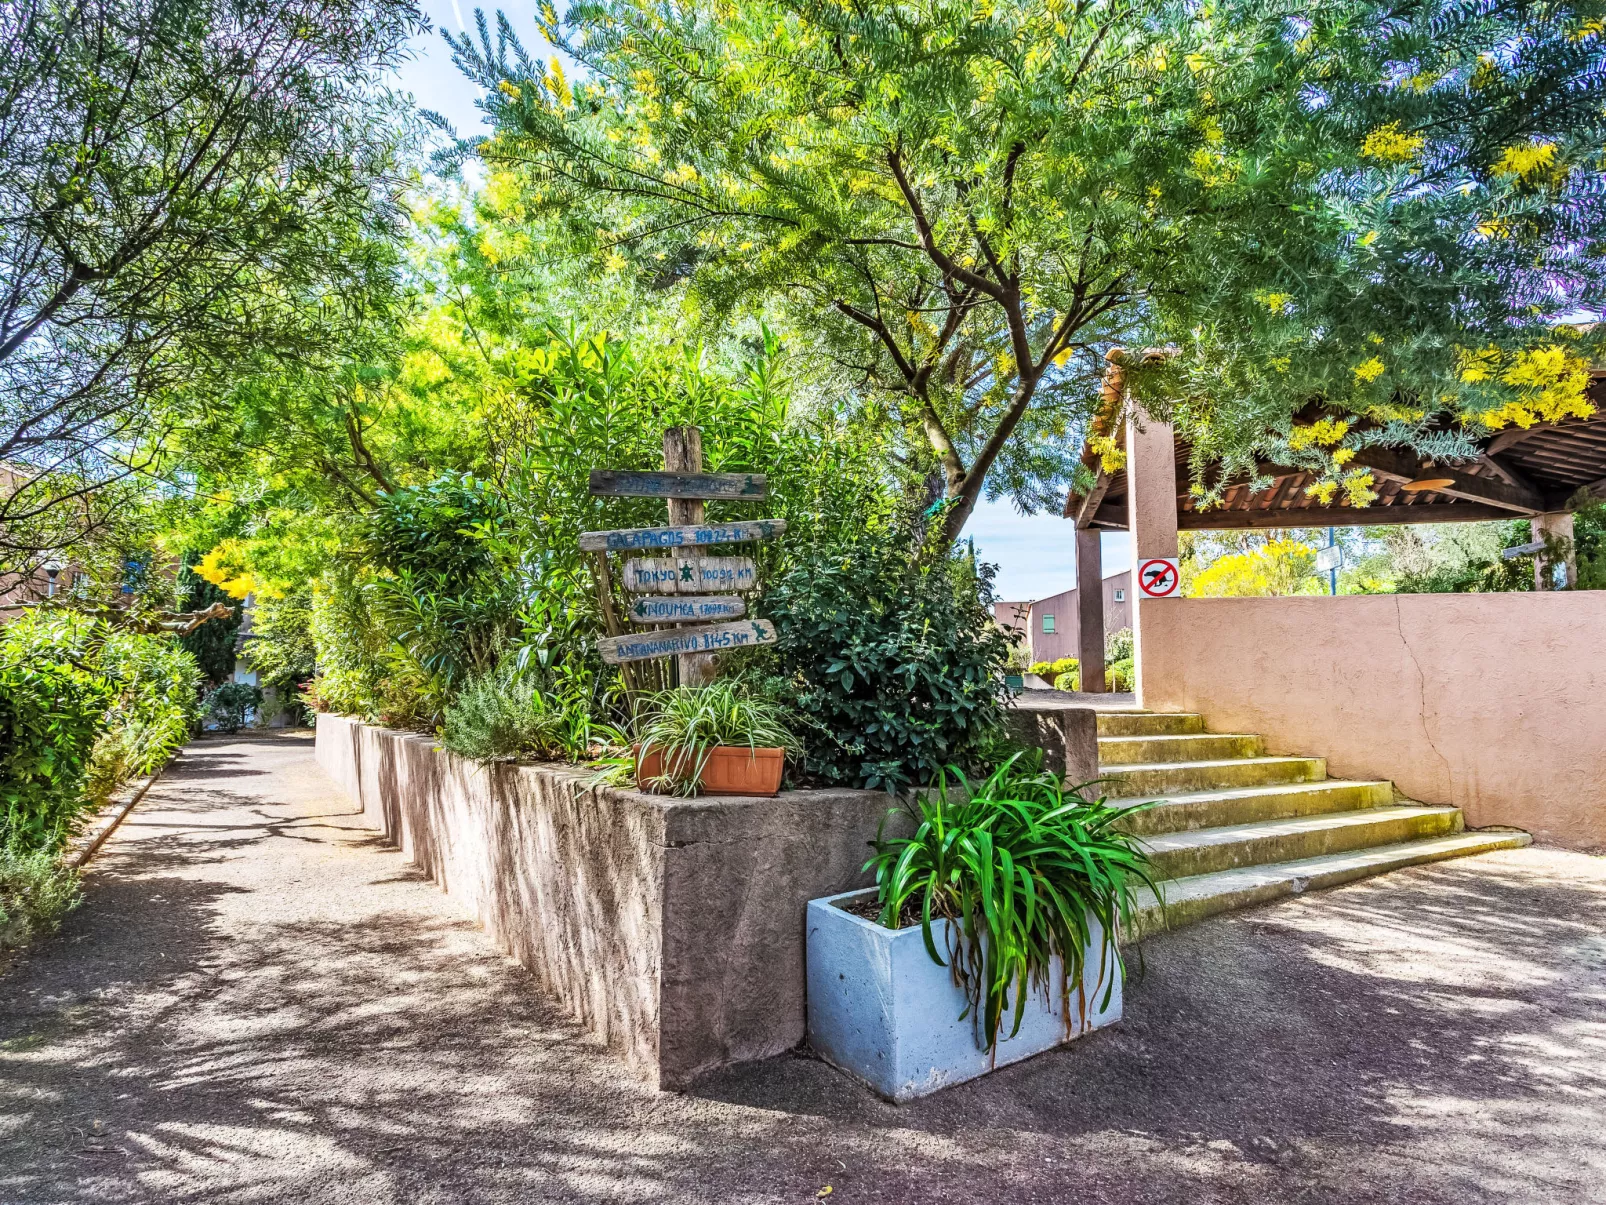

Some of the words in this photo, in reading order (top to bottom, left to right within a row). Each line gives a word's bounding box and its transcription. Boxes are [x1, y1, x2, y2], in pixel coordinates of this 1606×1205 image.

[635, 568, 676, 583] TOKYO
[737, 567, 752, 580] KM
[702, 631, 731, 648] 8145
